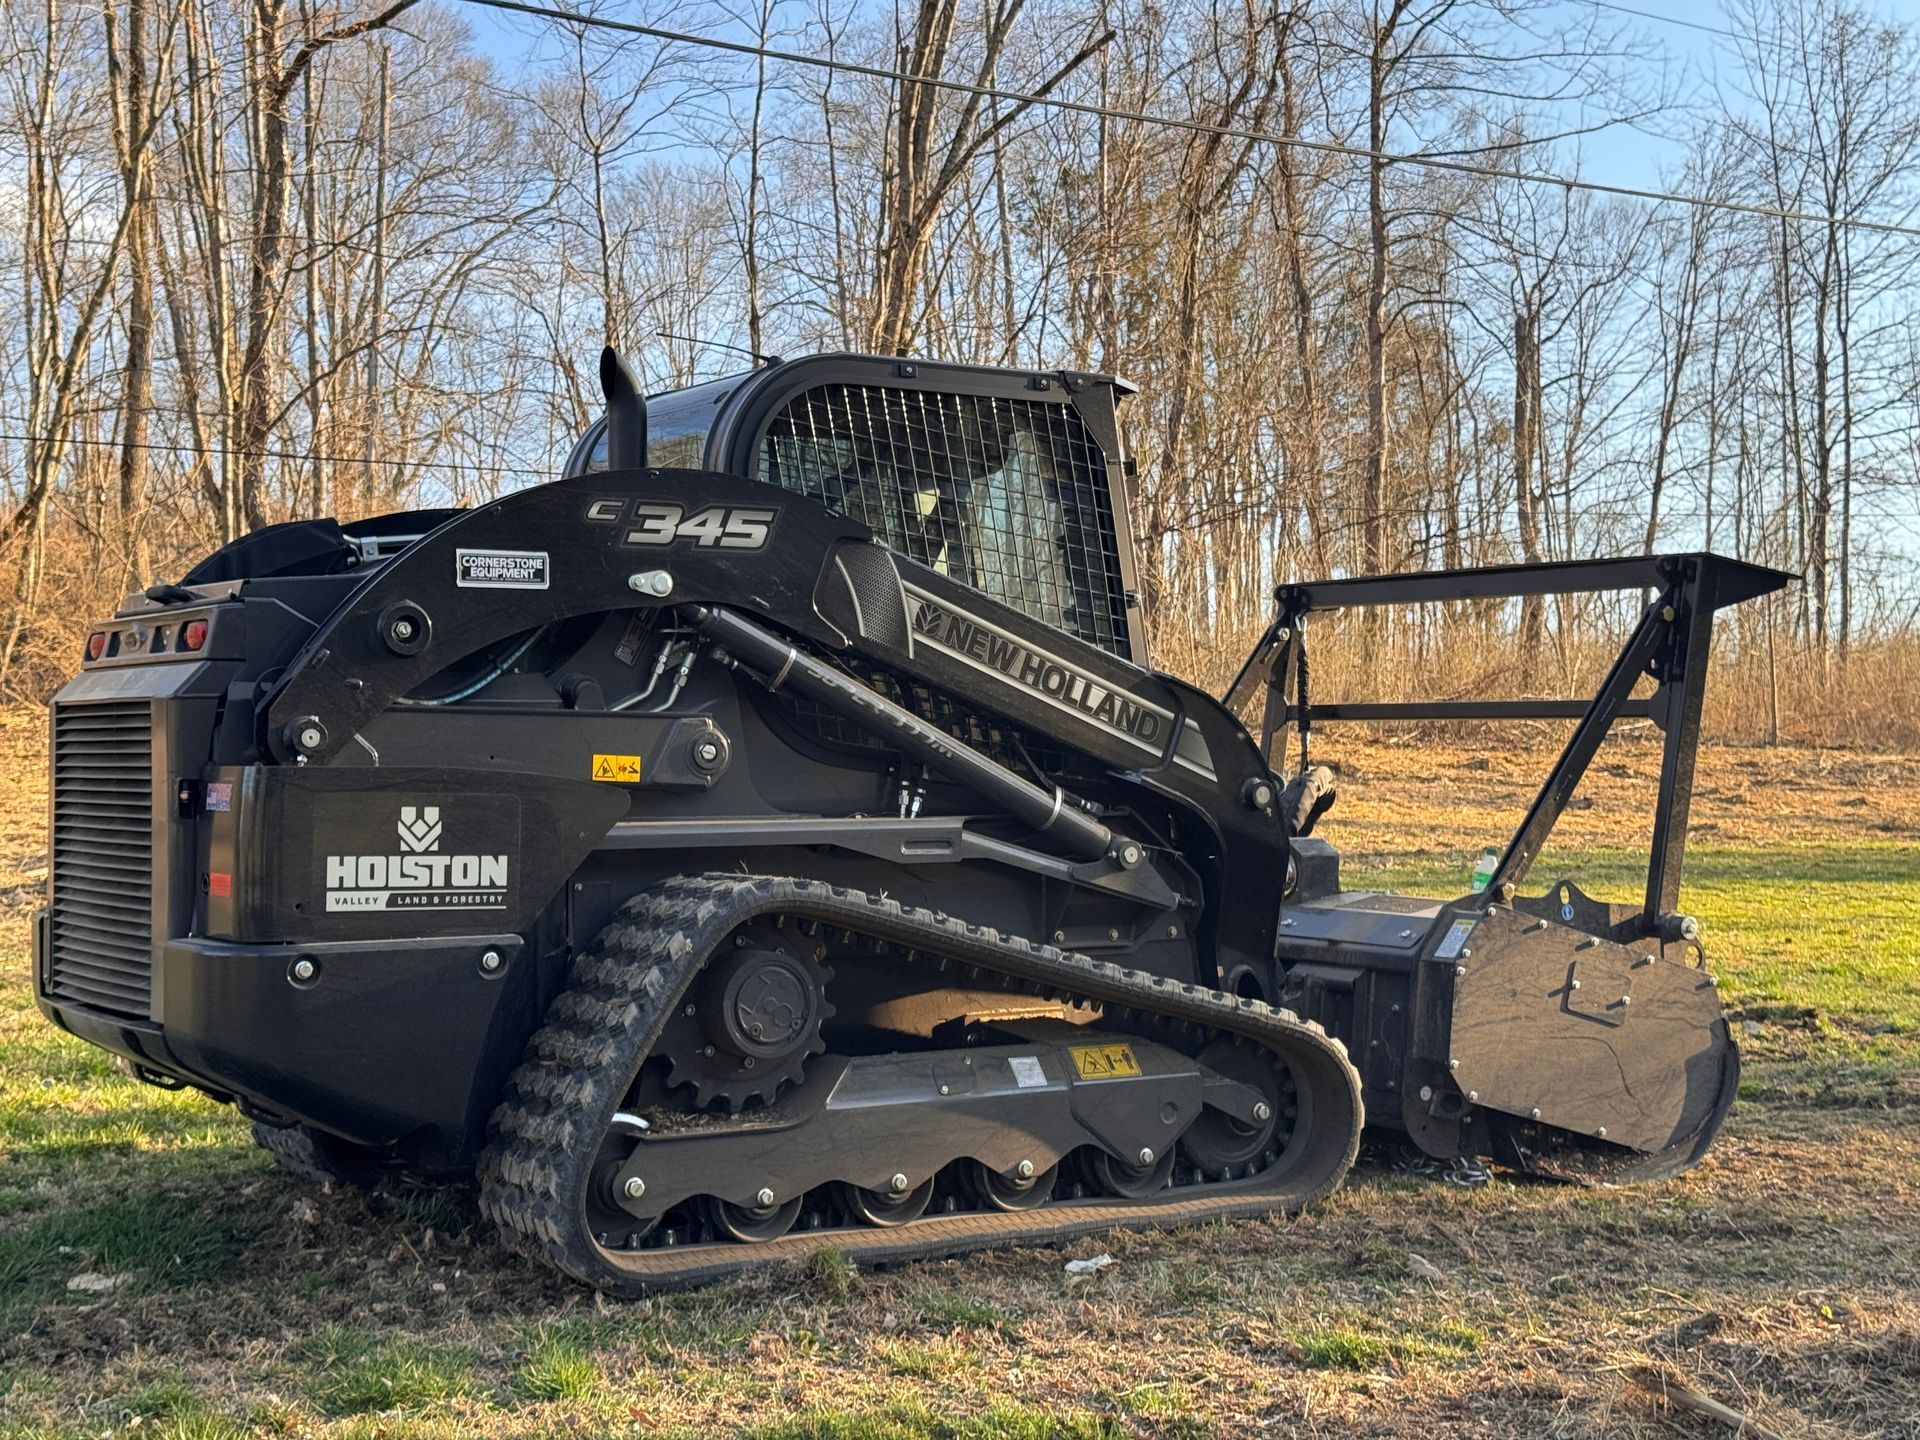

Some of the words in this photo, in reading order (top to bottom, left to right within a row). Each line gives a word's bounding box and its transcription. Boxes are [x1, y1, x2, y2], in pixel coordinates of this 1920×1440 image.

[587, 501, 623, 520] C
[626, 504, 775, 548] 345
[462, 556, 544, 569] CORNERSTONE
[470, 567, 535, 579] EQUIPMENT
[943, 615, 1021, 674] NEW
[1018, 652, 1160, 743] HOLLAND
[326, 855, 508, 888] HOLSTON
[335, 896, 379, 906] VALLEY
[397, 896, 428, 905] LAND
[445, 895, 504, 905] FORESTRY
